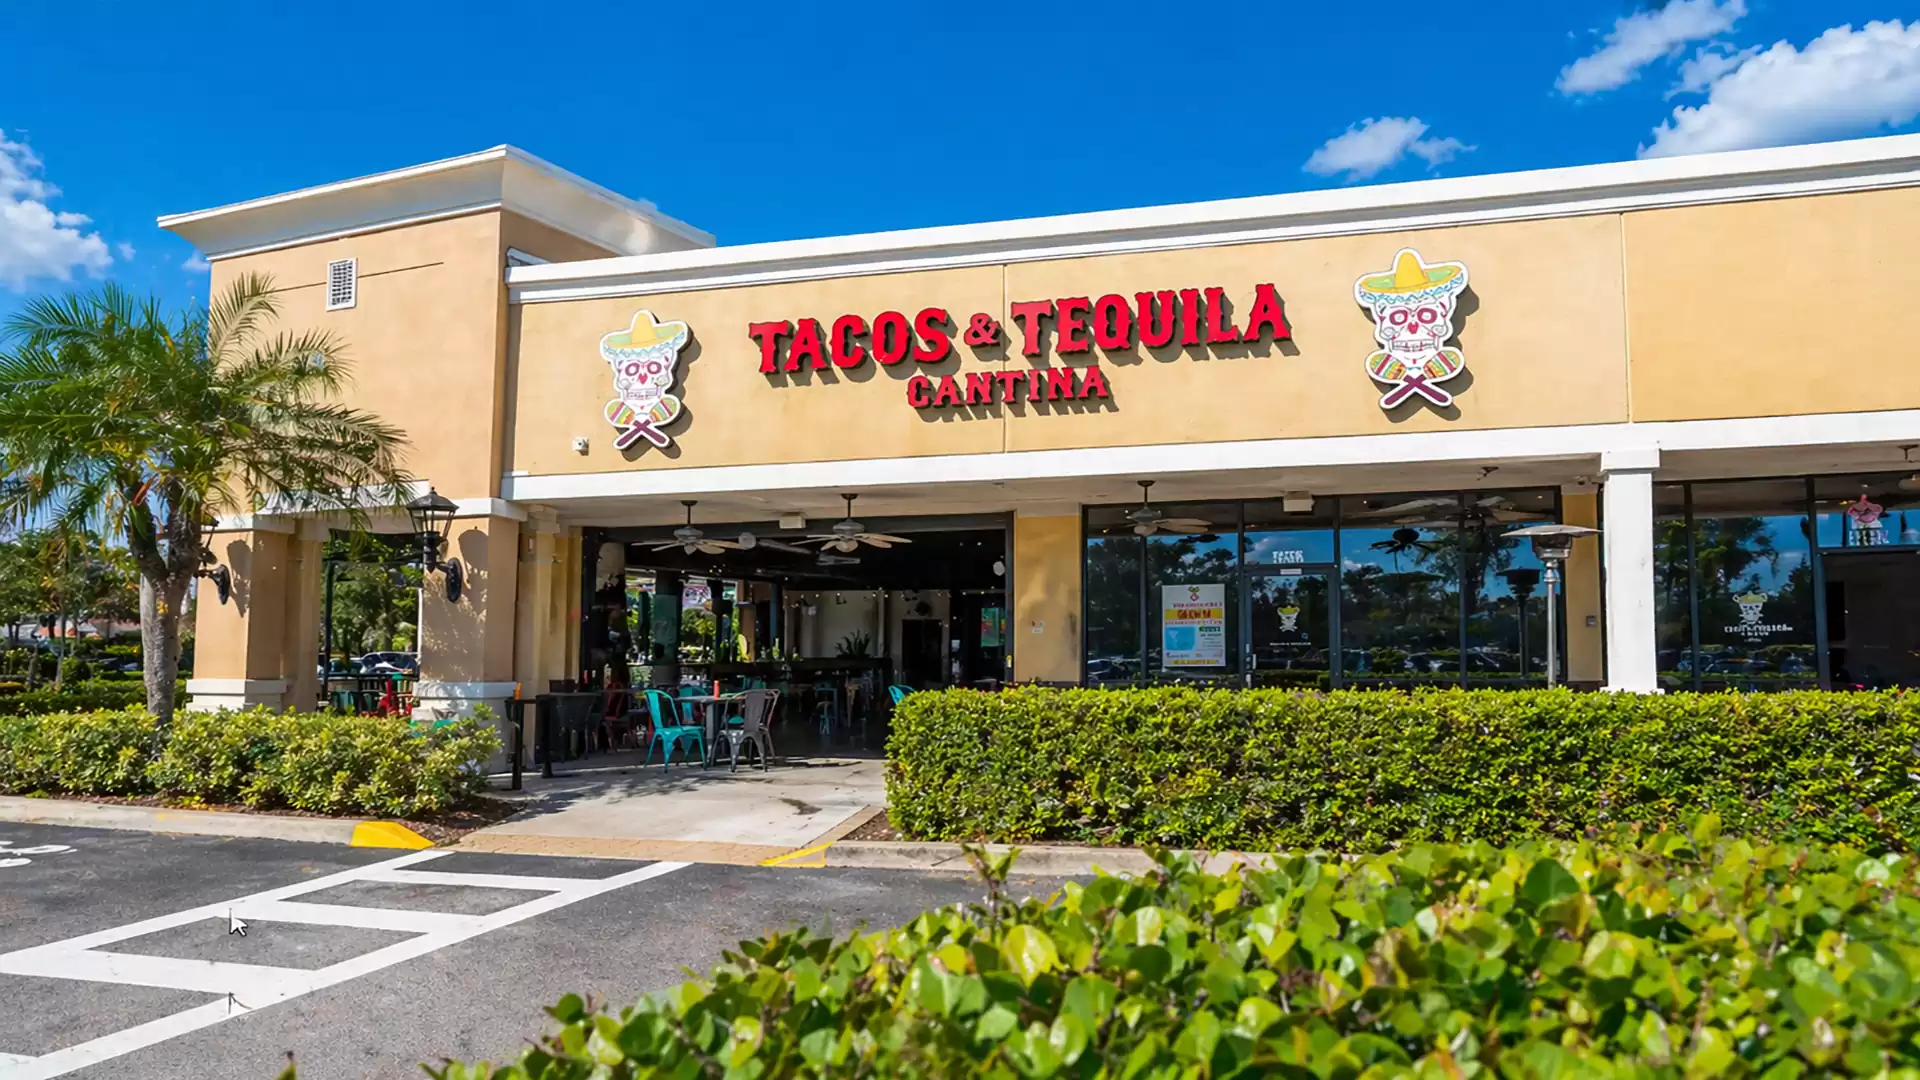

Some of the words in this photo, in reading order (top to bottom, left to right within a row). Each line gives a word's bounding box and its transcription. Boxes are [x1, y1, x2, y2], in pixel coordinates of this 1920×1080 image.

[748, 307, 952, 374] TACOS
[963, 312, 1000, 348] &
[1011, 283, 1292, 355] TEQUILA
[907, 365, 1109, 408] CANTINA
